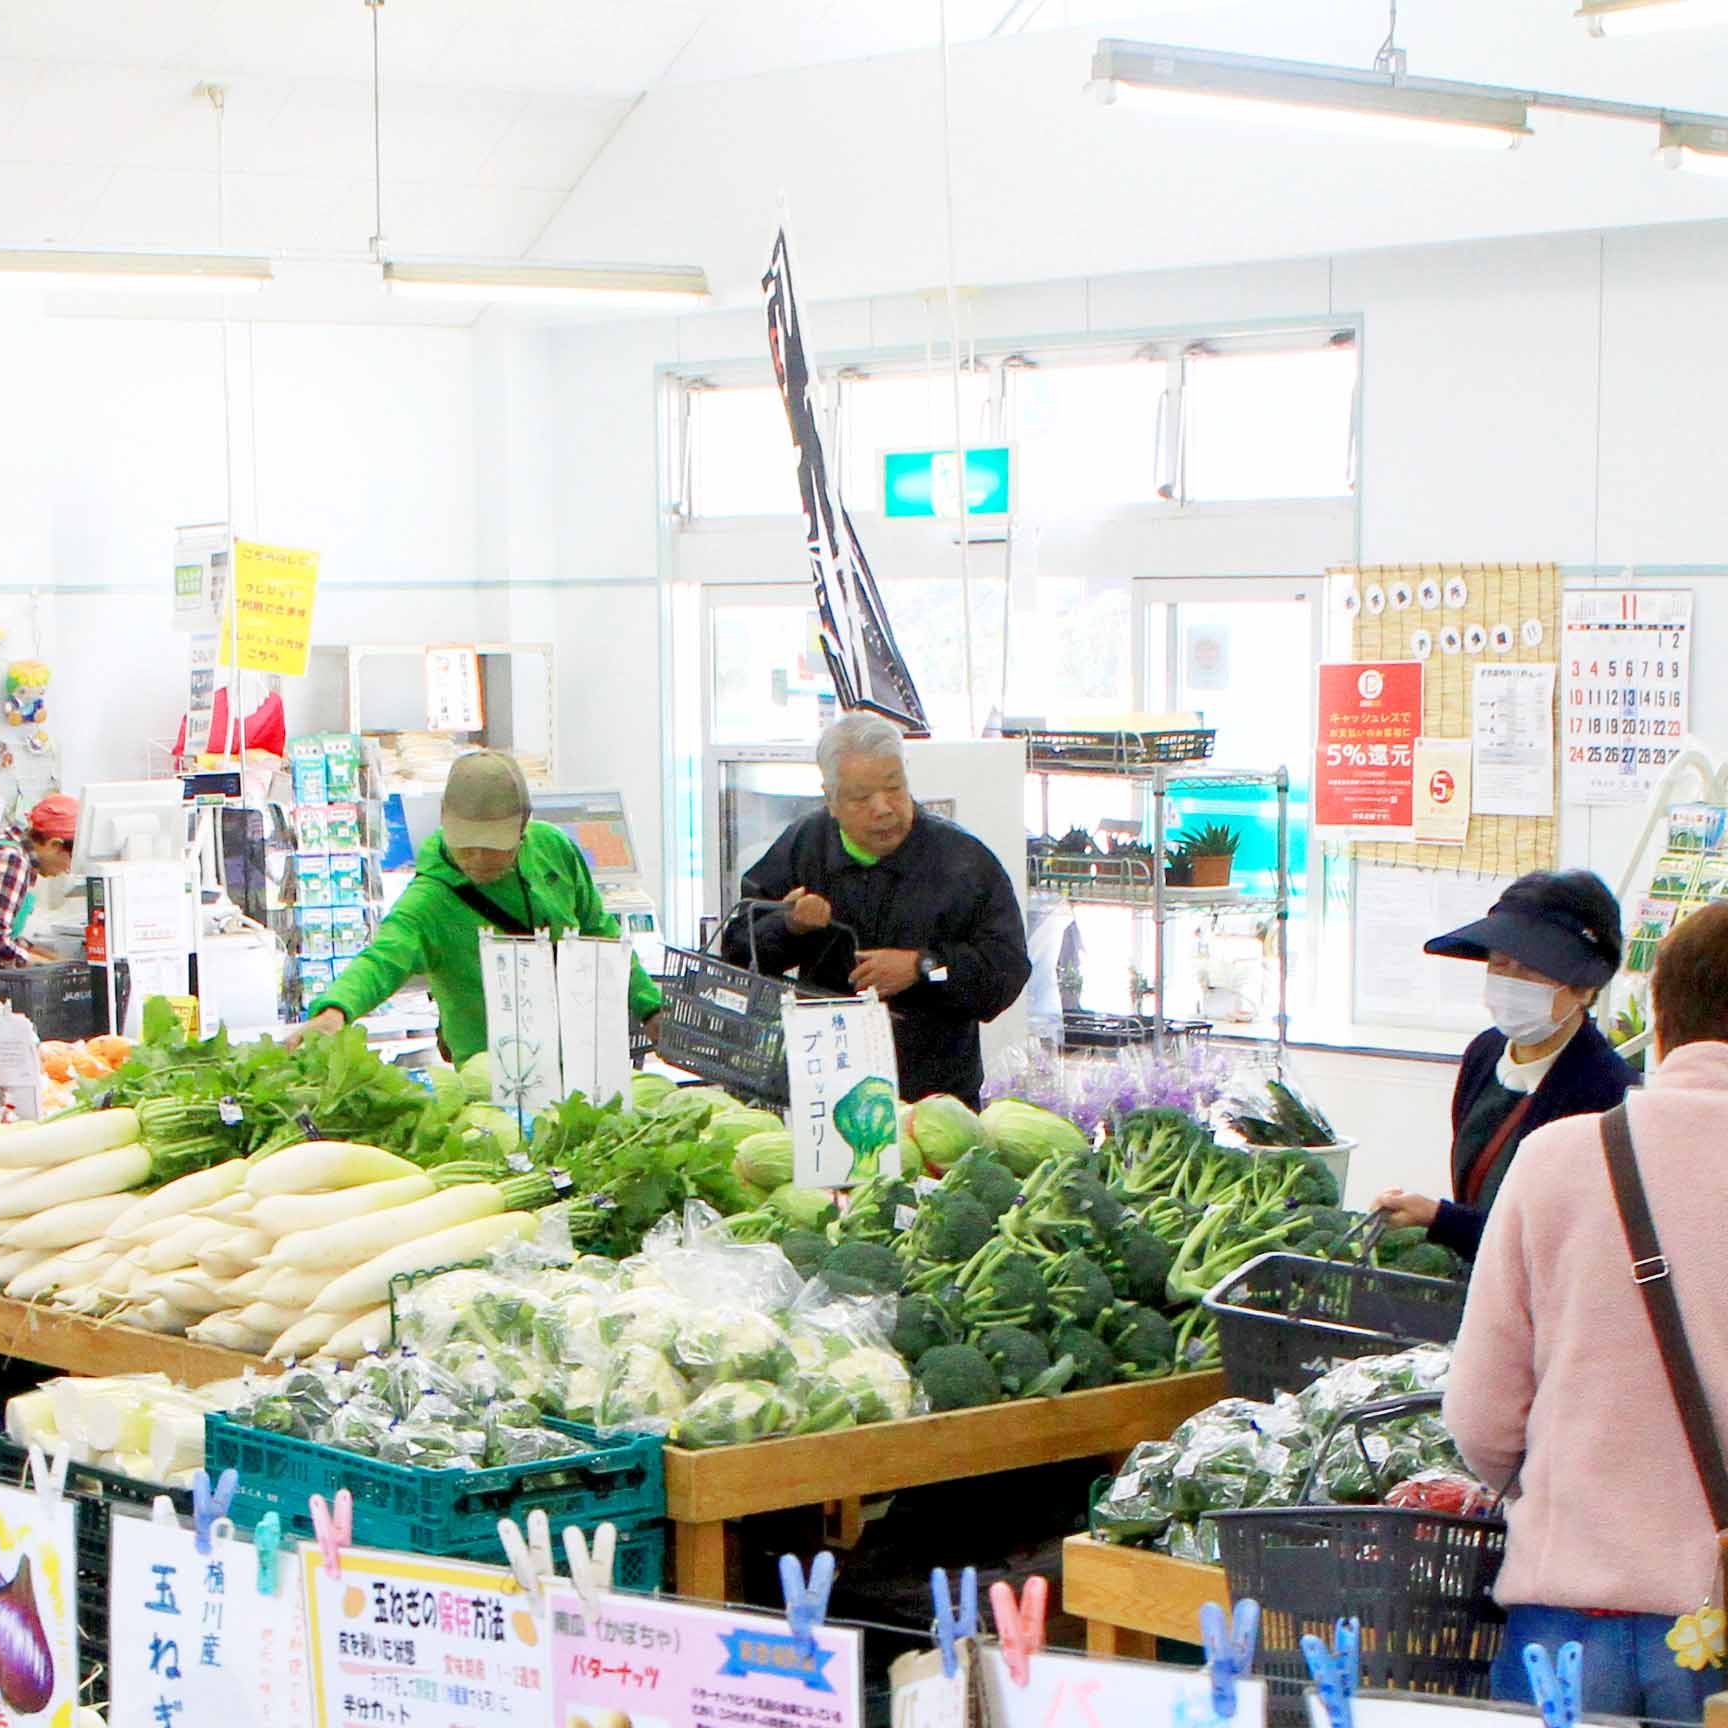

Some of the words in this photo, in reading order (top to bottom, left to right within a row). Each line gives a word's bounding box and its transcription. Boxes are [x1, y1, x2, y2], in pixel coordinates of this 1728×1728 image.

[1328, 711, 1411, 725] キャッシュレスで
[1326, 743, 1412, 768] 5%還元
[1431, 773, 1449, 801] 5
[801, 1031, 825, 1175] ブロッコリー
[371, 1581, 506, 1643] 玉ねぎの保存方法
[571, 1653, 661, 1690] バターナッツ
[343, 1693, 412, 1726] 半分カット
